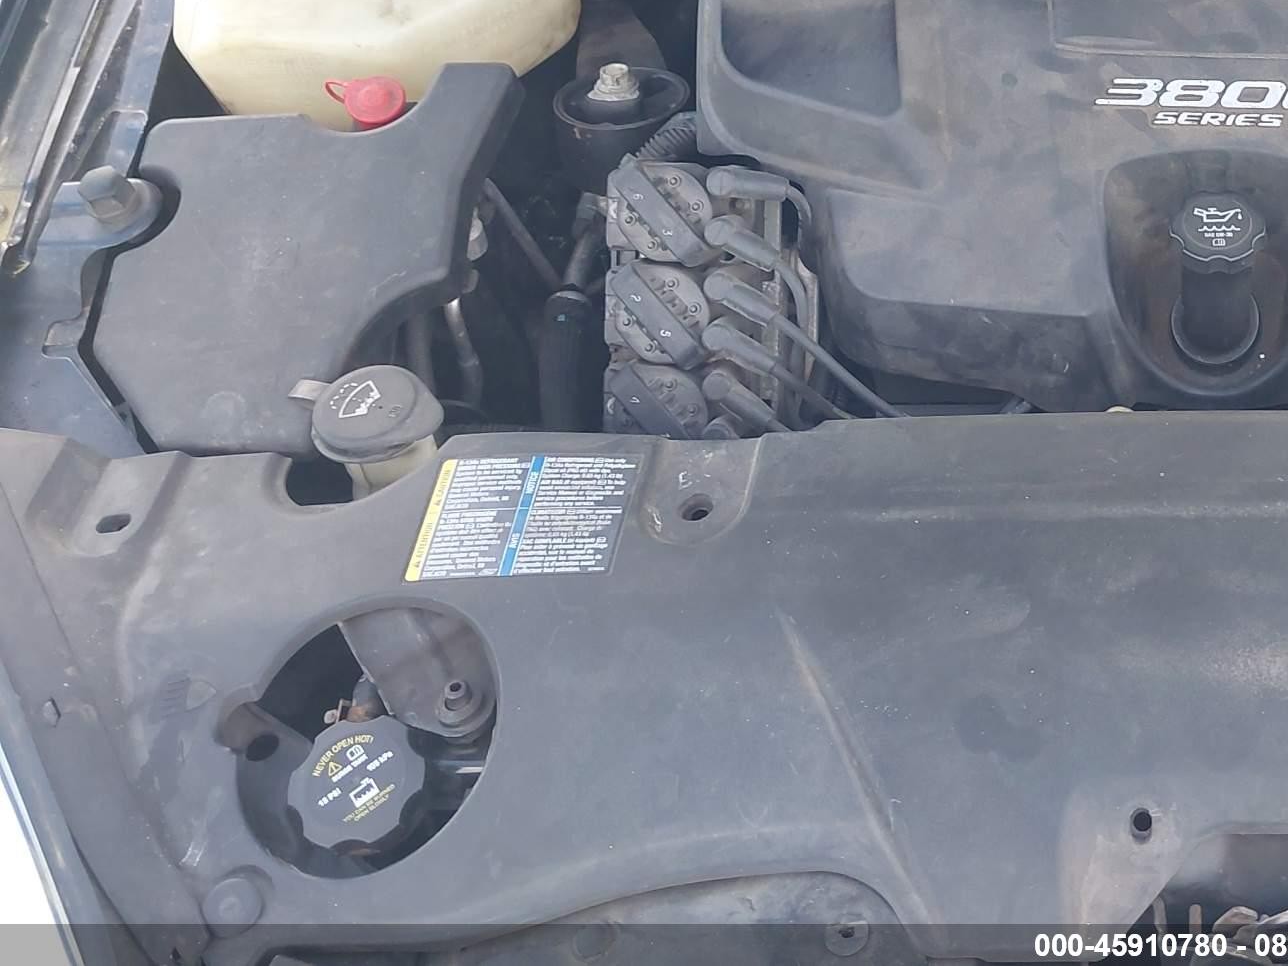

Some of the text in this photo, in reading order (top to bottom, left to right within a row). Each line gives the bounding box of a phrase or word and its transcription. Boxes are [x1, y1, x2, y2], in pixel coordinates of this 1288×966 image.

[1153, 111, 1284, 127] SERIES
[524, 471, 537, 494] NOTICE
[312, 750, 335, 778] NEVER
[331, 736, 354, 754] OPEN
